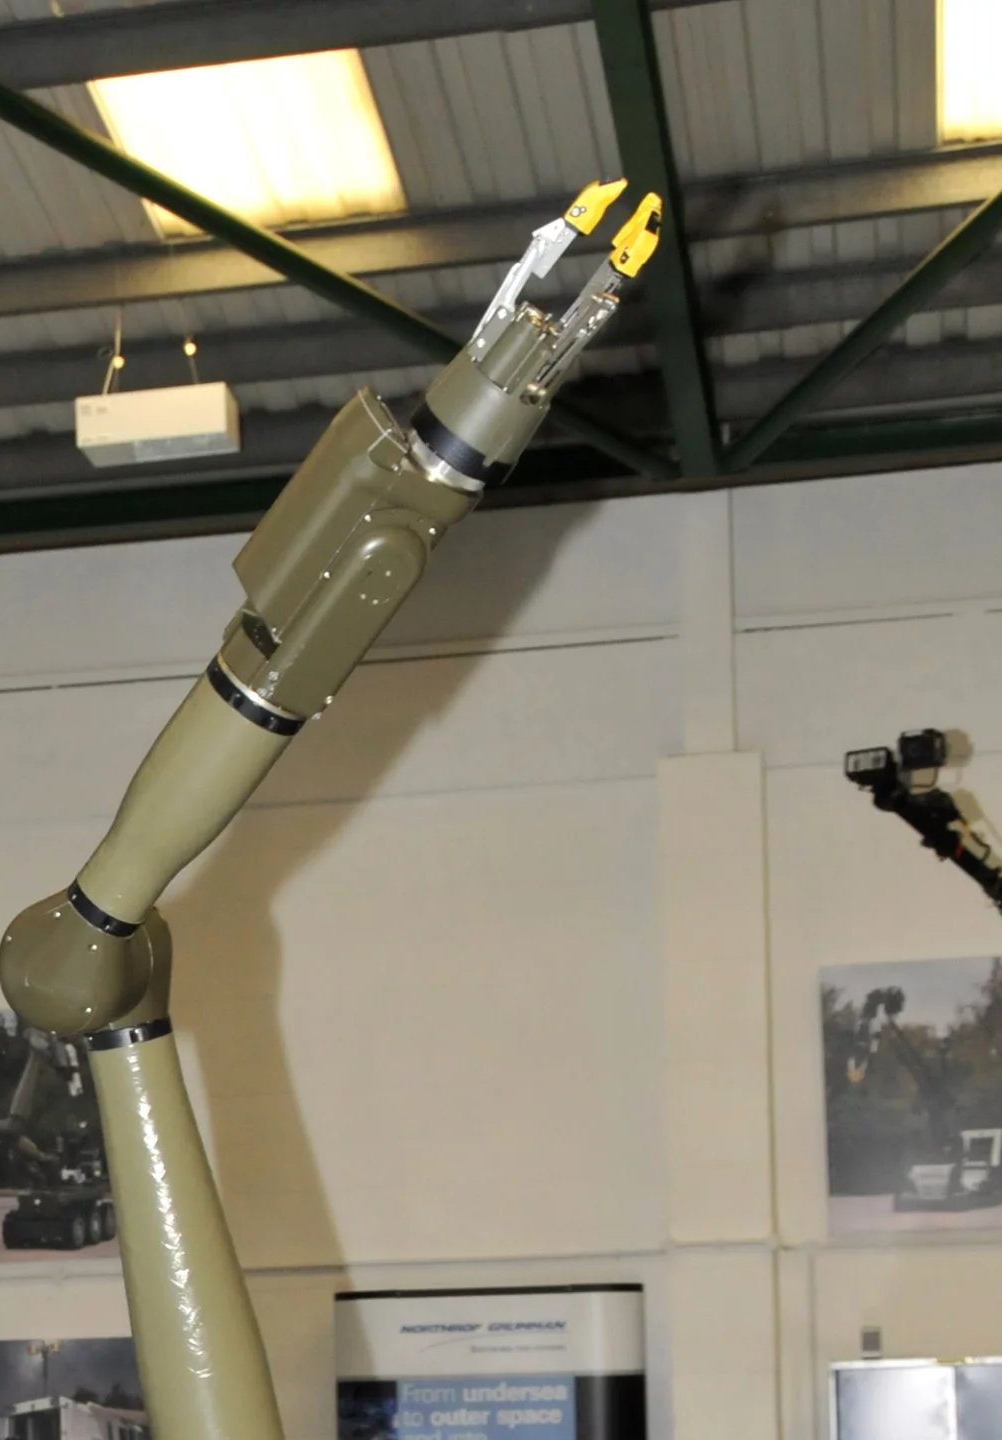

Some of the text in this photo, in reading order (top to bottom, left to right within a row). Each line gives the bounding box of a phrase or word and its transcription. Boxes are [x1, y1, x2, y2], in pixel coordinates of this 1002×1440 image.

[402, 1382, 567, 1402] From undersea
[403, 1408, 562, 1429] to outer space
